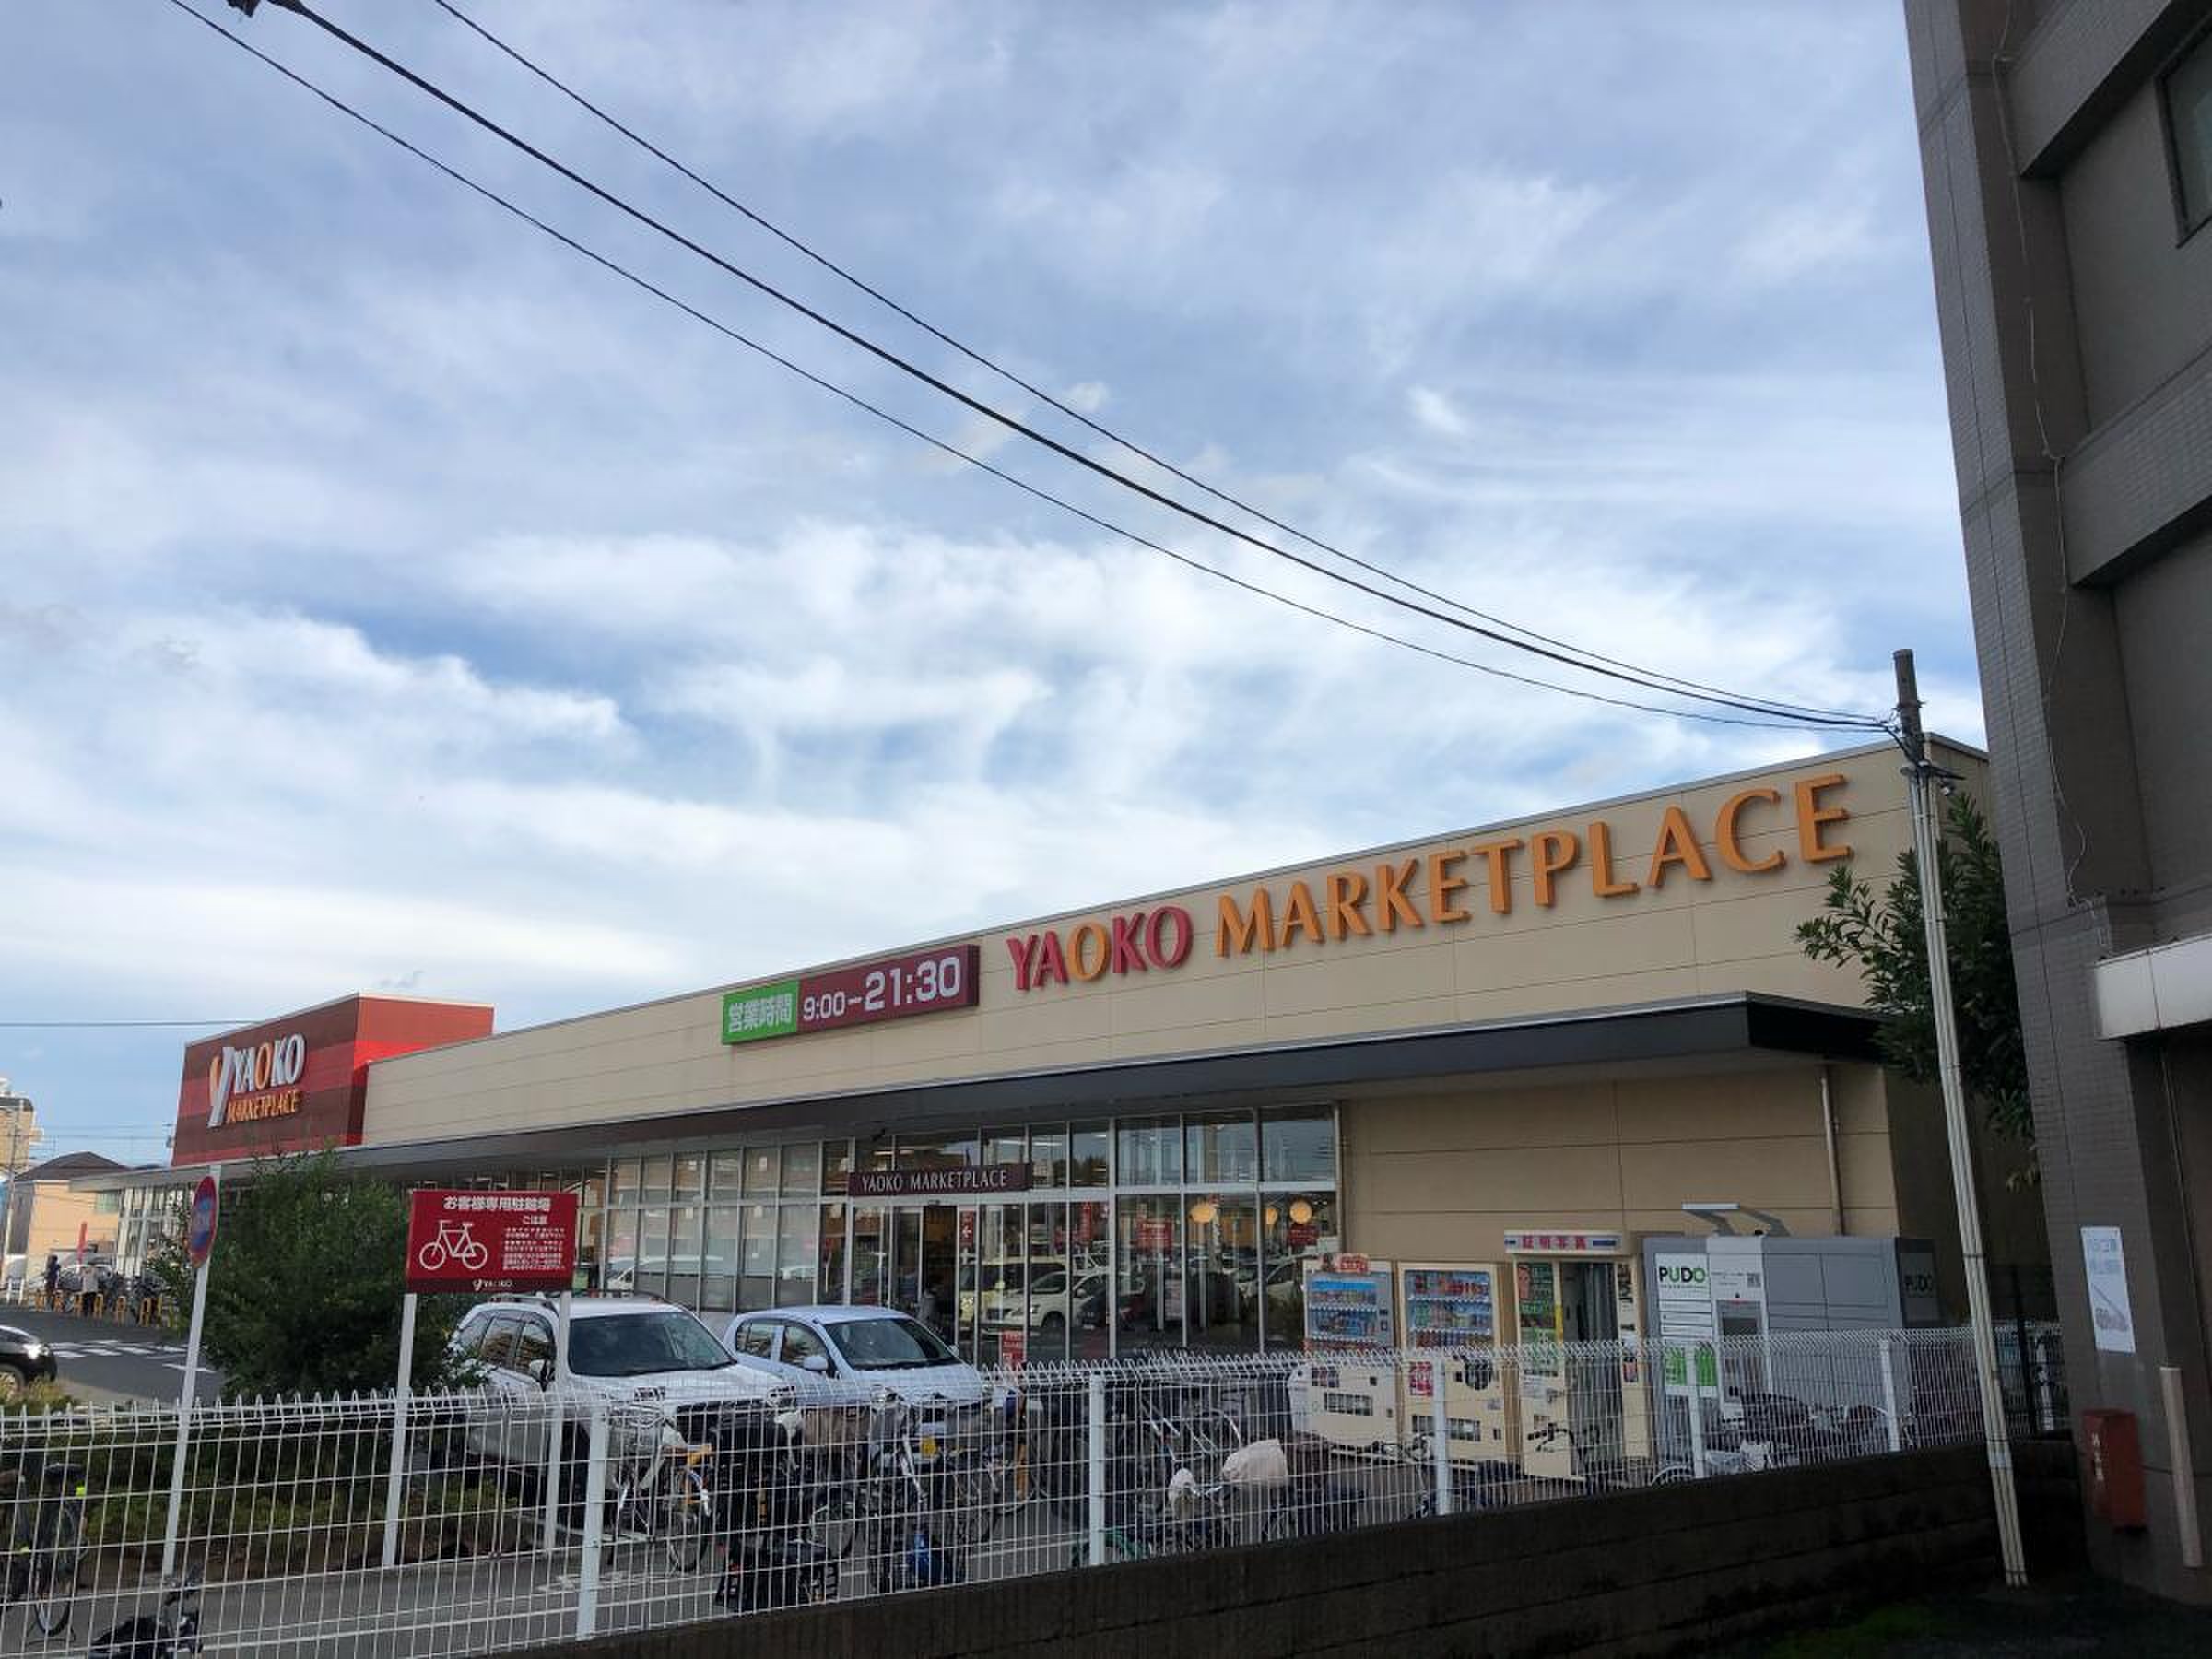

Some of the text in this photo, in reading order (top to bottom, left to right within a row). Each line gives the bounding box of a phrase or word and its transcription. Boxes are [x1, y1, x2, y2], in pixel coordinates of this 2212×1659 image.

[1006, 774, 1852, 991] YAOKO MARKETPLACE
[728, 993, 793, 1033] 営業時間
[233, 1033, 306, 1095] YAOKO
[861, 1169, 1007, 1192] YAOKO MARKETPLACE
[1659, 1266, 1706, 1284] PUDO
